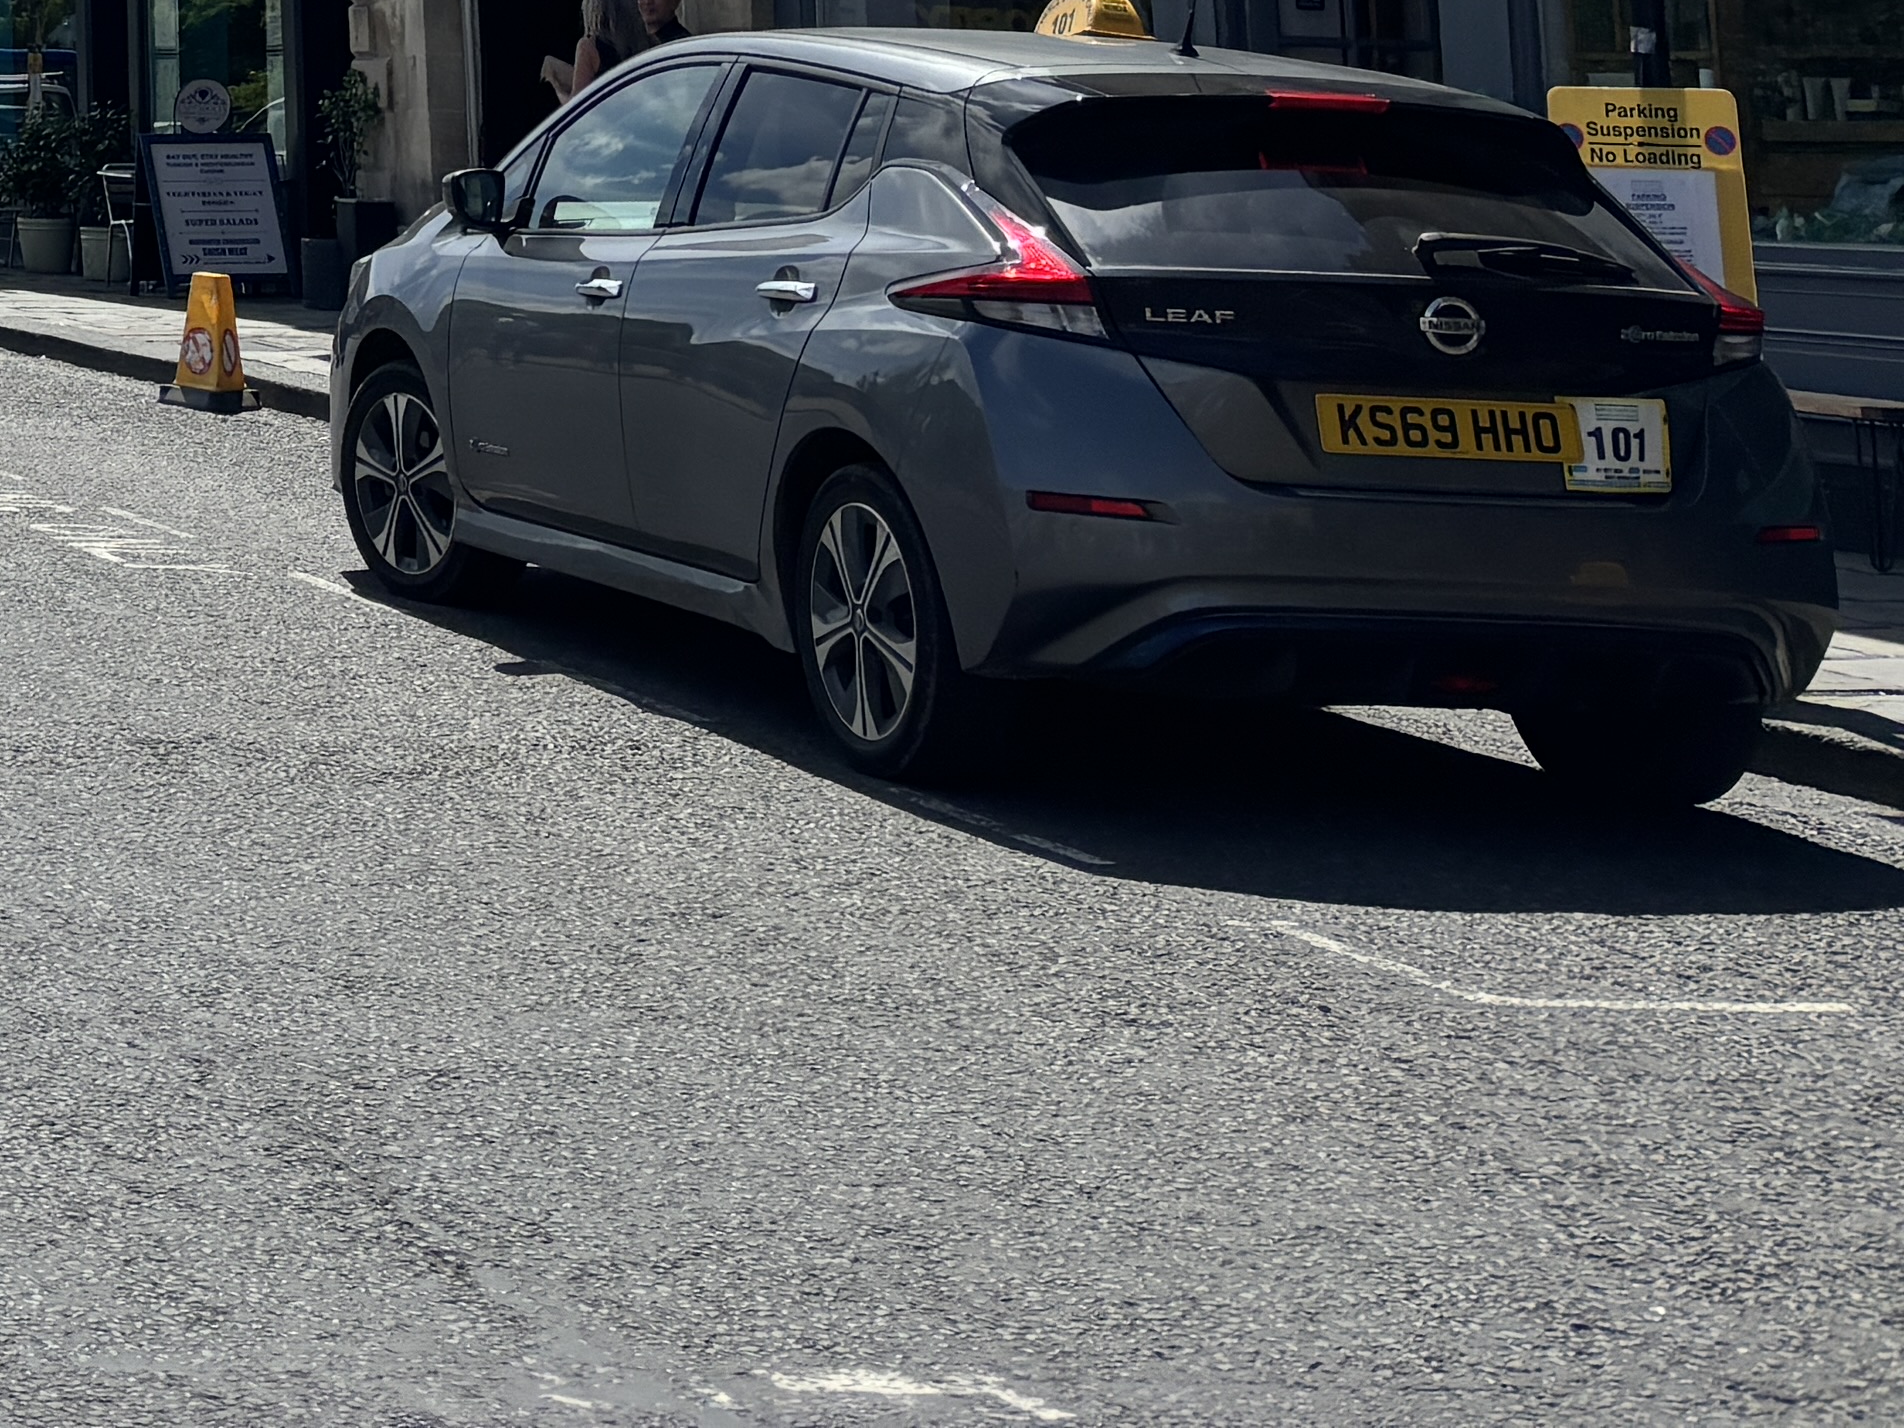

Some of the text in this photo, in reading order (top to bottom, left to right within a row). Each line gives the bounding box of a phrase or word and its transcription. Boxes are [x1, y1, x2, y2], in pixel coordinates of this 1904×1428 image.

[1052, 7, 1076, 35] 101
[1604, 102, 1678, 123] Parking
[1586, 121, 1701, 141] Suspension
[1590, 147, 1702, 169] No Loading
[1144, 307, 1235, 324] LEAF
[1336, 403, 1460, 450] KS69
[1470, 408, 1562, 455] HHO
[1586, 425, 1646, 463] 101
